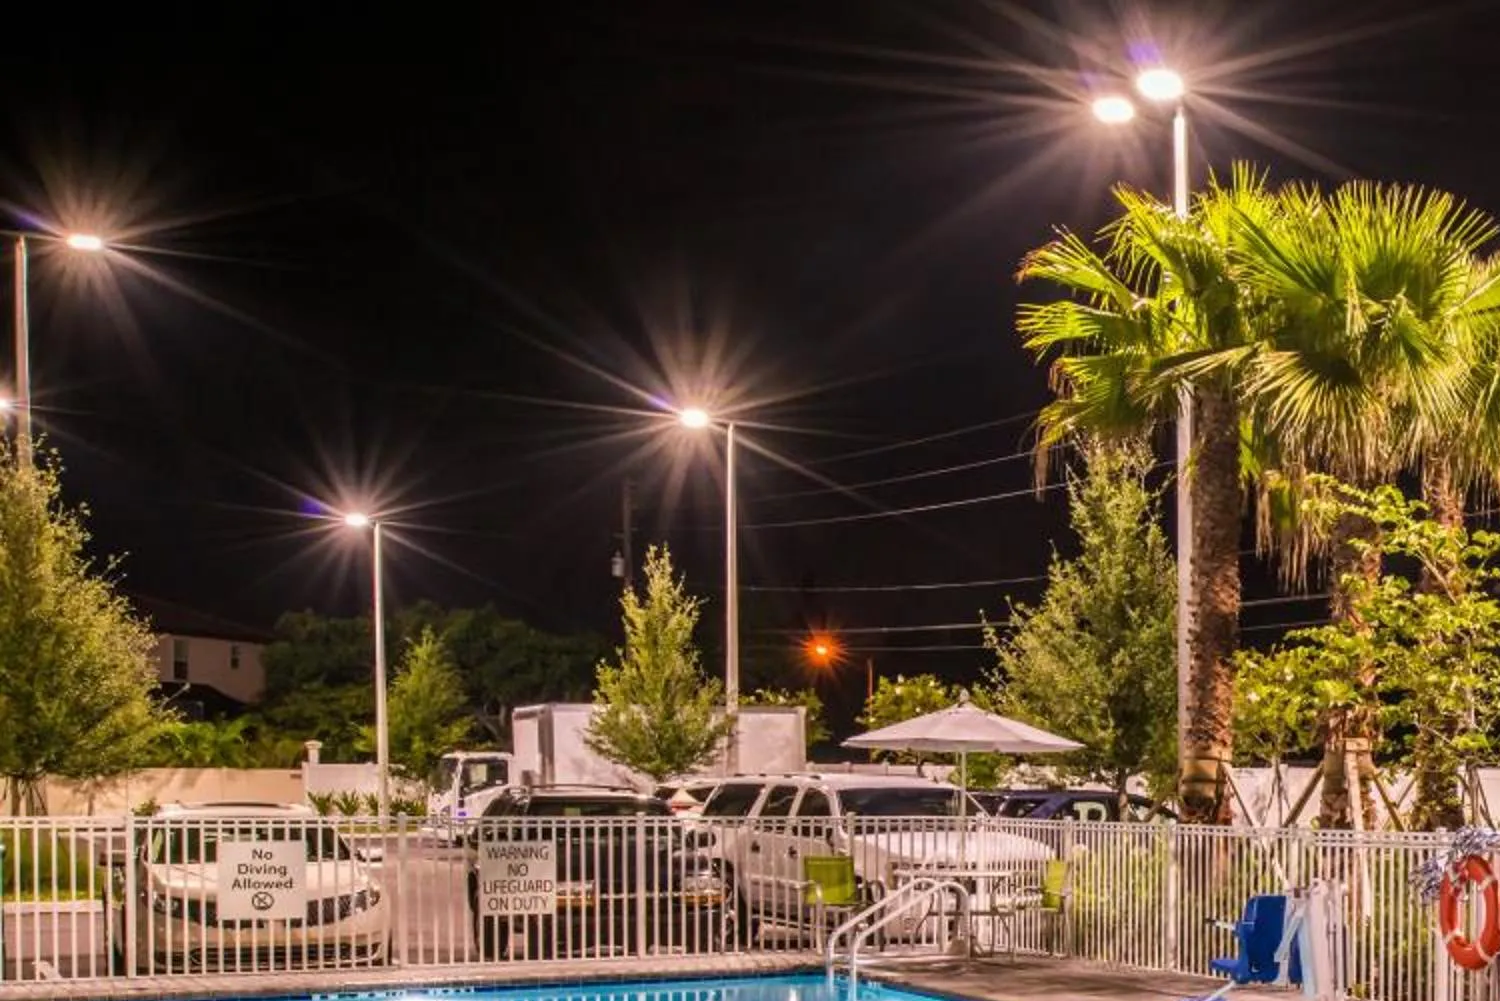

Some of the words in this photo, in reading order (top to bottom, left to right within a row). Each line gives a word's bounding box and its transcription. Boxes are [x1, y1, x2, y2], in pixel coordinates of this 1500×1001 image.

[252, 849, 273, 860] No
[487, 846, 549, 860] WARNING
[237, 863, 287, 878] Diving
[507, 863, 529, 876] NO
[231, 878, 293, 890] Allowed
[483, 880, 554, 894] LIFEGUARD
[488, 897, 509, 911] ON
[513, 895, 549, 910] DUTY
